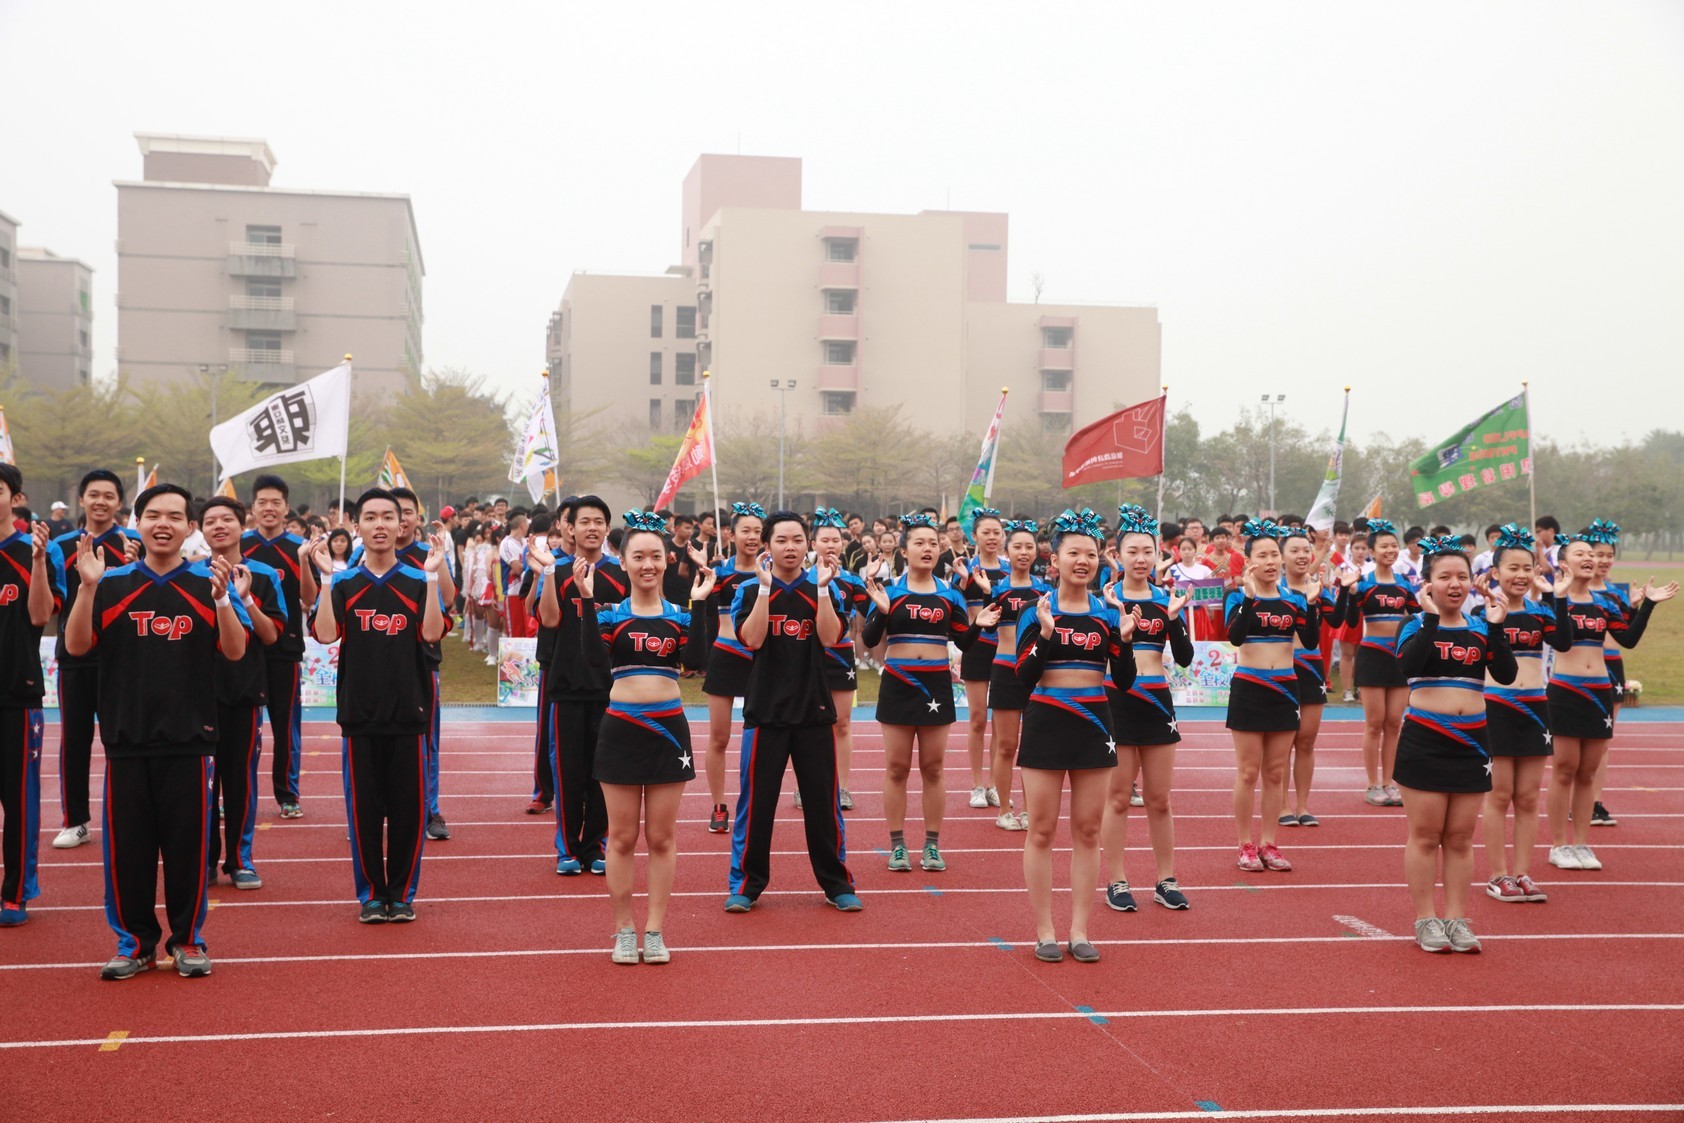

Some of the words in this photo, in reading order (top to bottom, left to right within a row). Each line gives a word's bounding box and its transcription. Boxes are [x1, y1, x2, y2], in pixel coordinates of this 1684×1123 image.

[1375, 594, 1405, 609] Top
[355, 609, 408, 636] Top
[905, 604, 944, 623] Top
[1256, 611, 1294, 631] Top
[1571, 614, 1607, 633] Top
[128, 611, 193, 641] Top
[768, 614, 814, 641] Top
[1136, 617, 1164, 636] op
[628, 632, 677, 657] Top
[1055, 627, 1102, 650] Top
[1504, 627, 1543, 647] Top
[1434, 641, 1482, 666] Top
